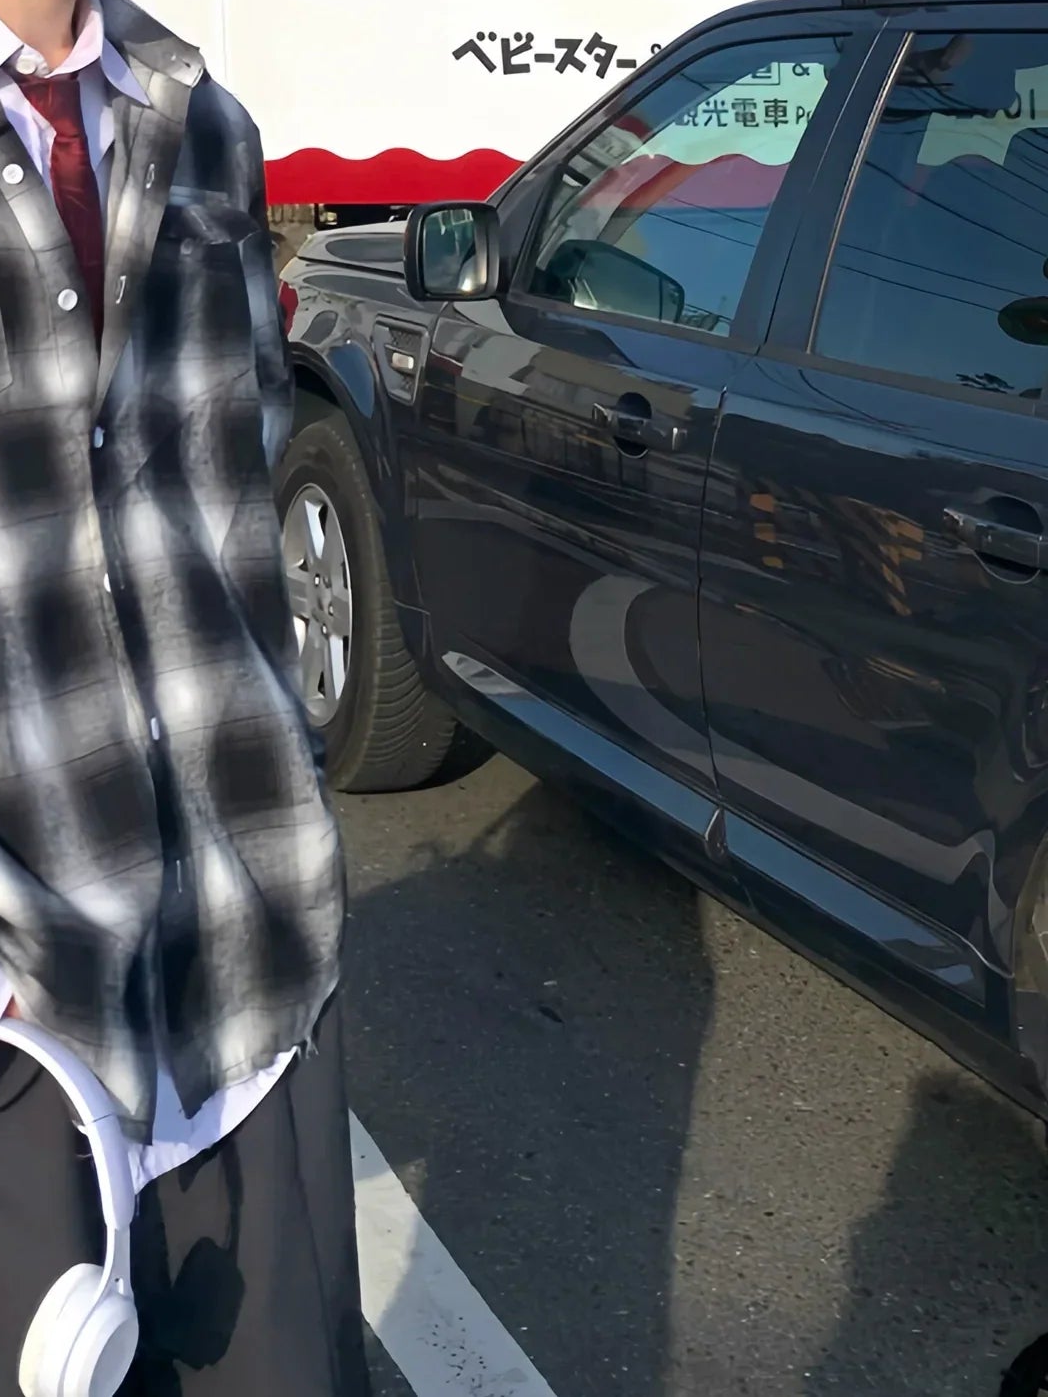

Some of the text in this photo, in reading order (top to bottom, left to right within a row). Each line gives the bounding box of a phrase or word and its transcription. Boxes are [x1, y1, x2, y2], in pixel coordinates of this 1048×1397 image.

[452, 31, 637, 80] ベビースター
